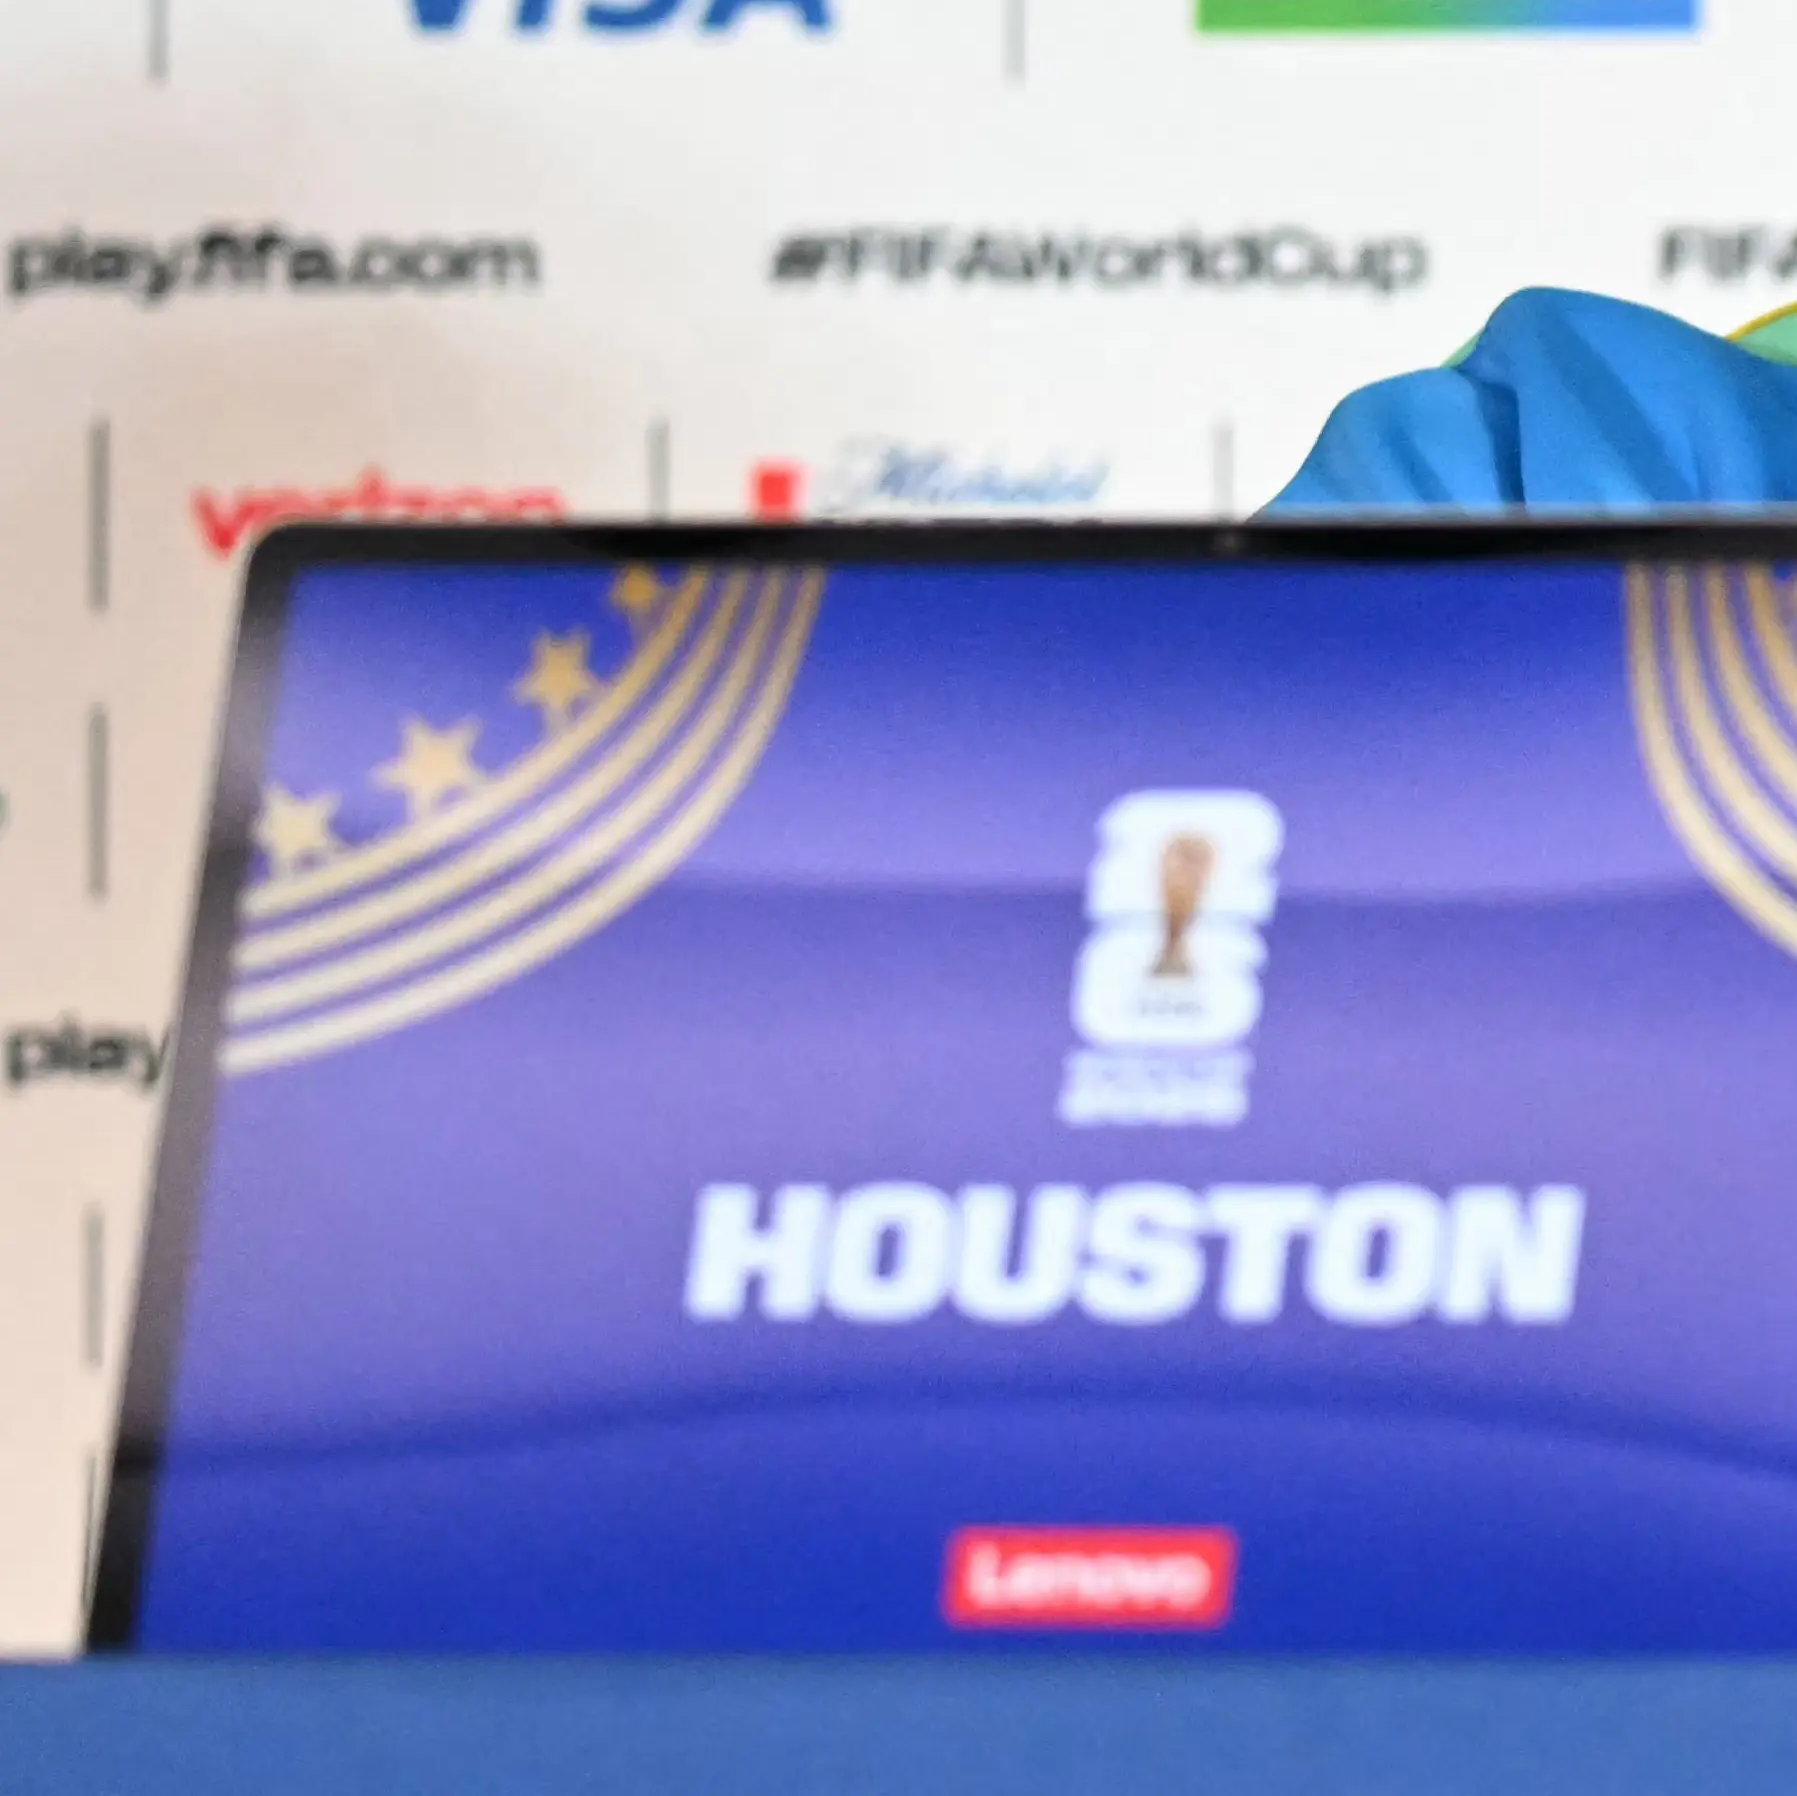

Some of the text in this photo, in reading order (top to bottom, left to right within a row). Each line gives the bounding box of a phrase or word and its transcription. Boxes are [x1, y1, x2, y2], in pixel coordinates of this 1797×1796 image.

[768, 225, 1427, 295] #FIFAWorldCup
[685, 1181, 1586, 1324] HOUSTON
[970, 1547, 1208, 1606] Lenovo
